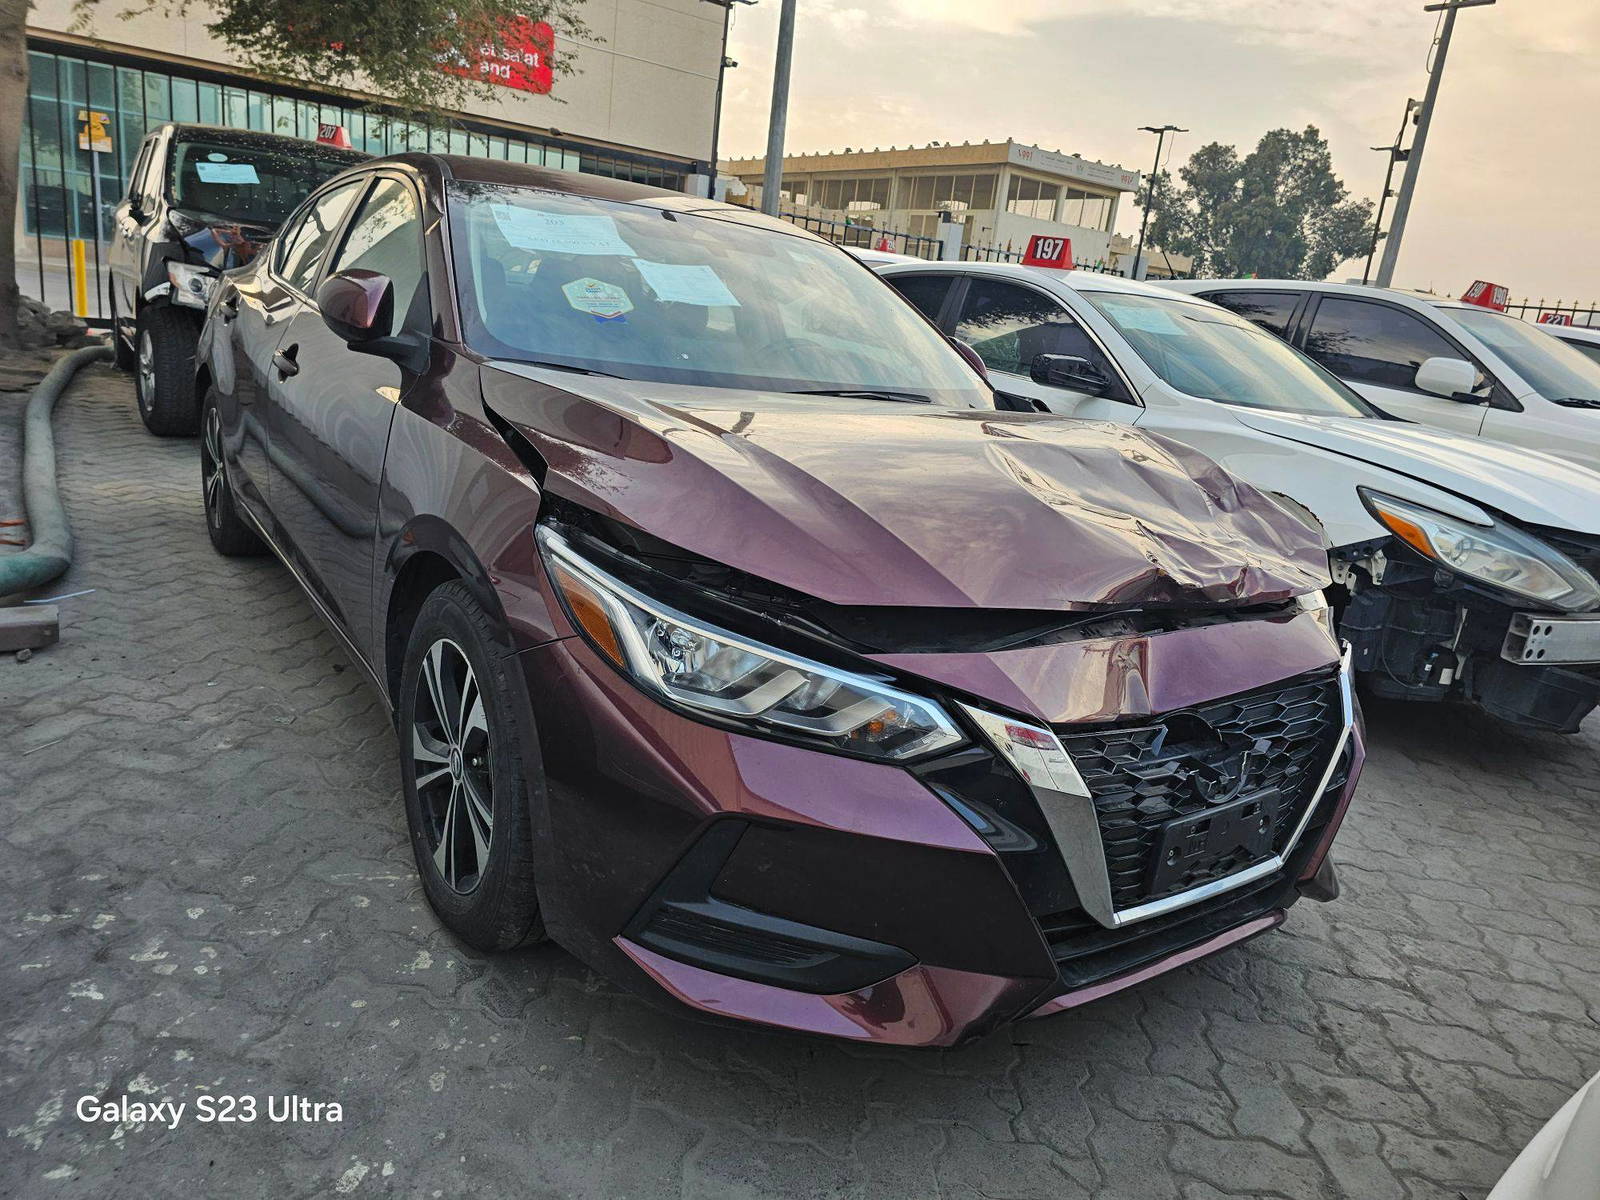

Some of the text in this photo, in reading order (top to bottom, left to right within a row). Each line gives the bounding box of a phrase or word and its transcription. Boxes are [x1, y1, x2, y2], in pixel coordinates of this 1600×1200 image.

[480, 43, 540, 67] etsaat
[320, 125, 337, 139] 207
[1035, 238, 1064, 261] 197
[1546, 314, 1566, 326] 221
